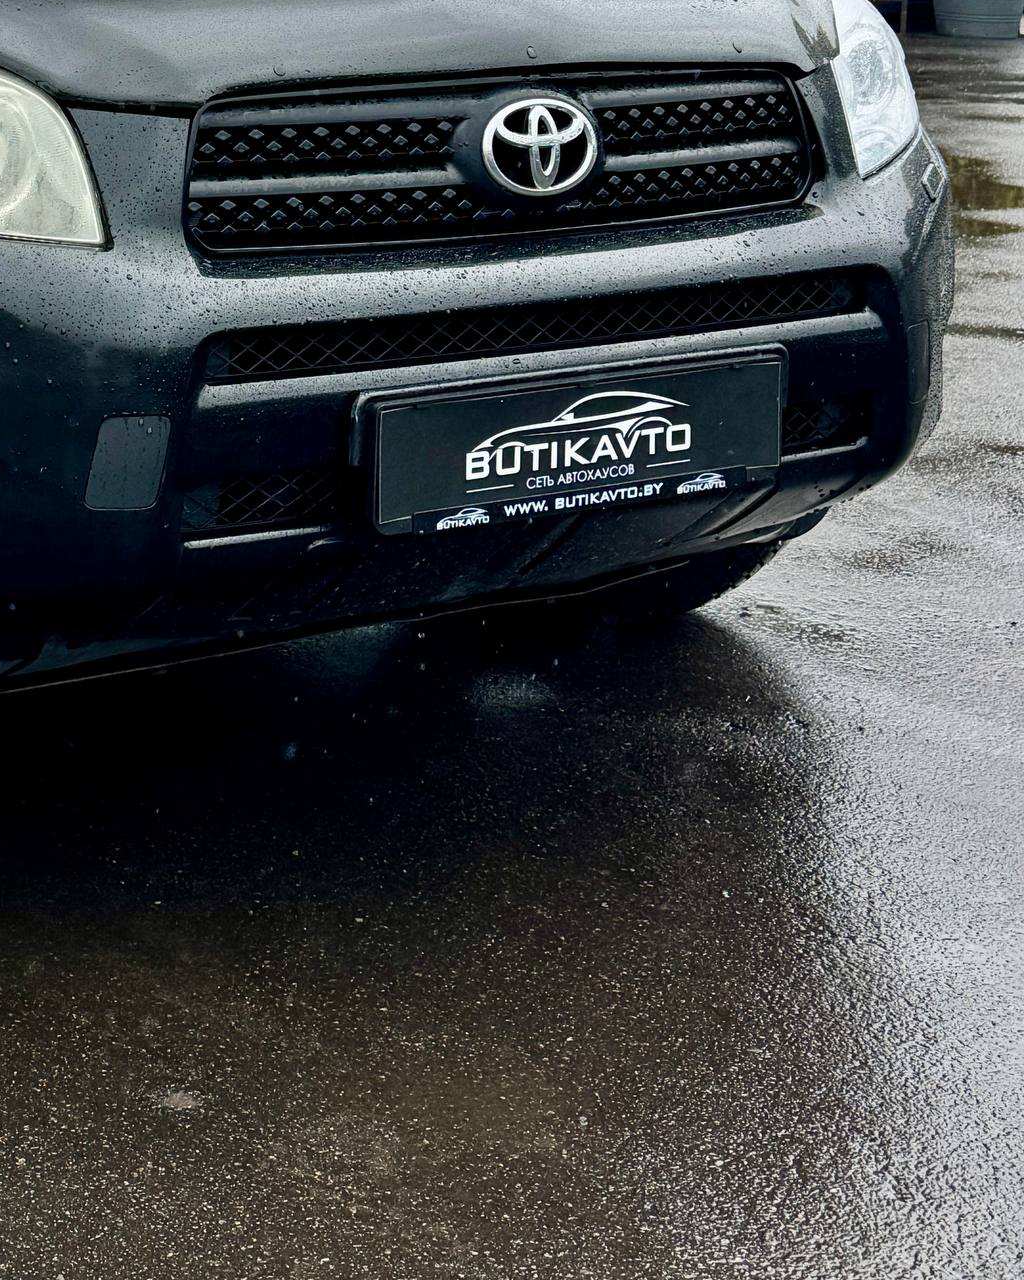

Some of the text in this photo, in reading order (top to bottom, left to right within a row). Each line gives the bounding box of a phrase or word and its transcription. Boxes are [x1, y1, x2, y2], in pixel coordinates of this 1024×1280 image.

[465, 423, 691, 481] BUTIKAVTO
[526, 463, 635, 490] СЕТЬ АВТОХАУСОВ
[676, 479, 726, 495] BUTIKAVTO
[504, 500, 548, 517] WWW.
[436, 513, 490, 531] BUTIKAVTO
